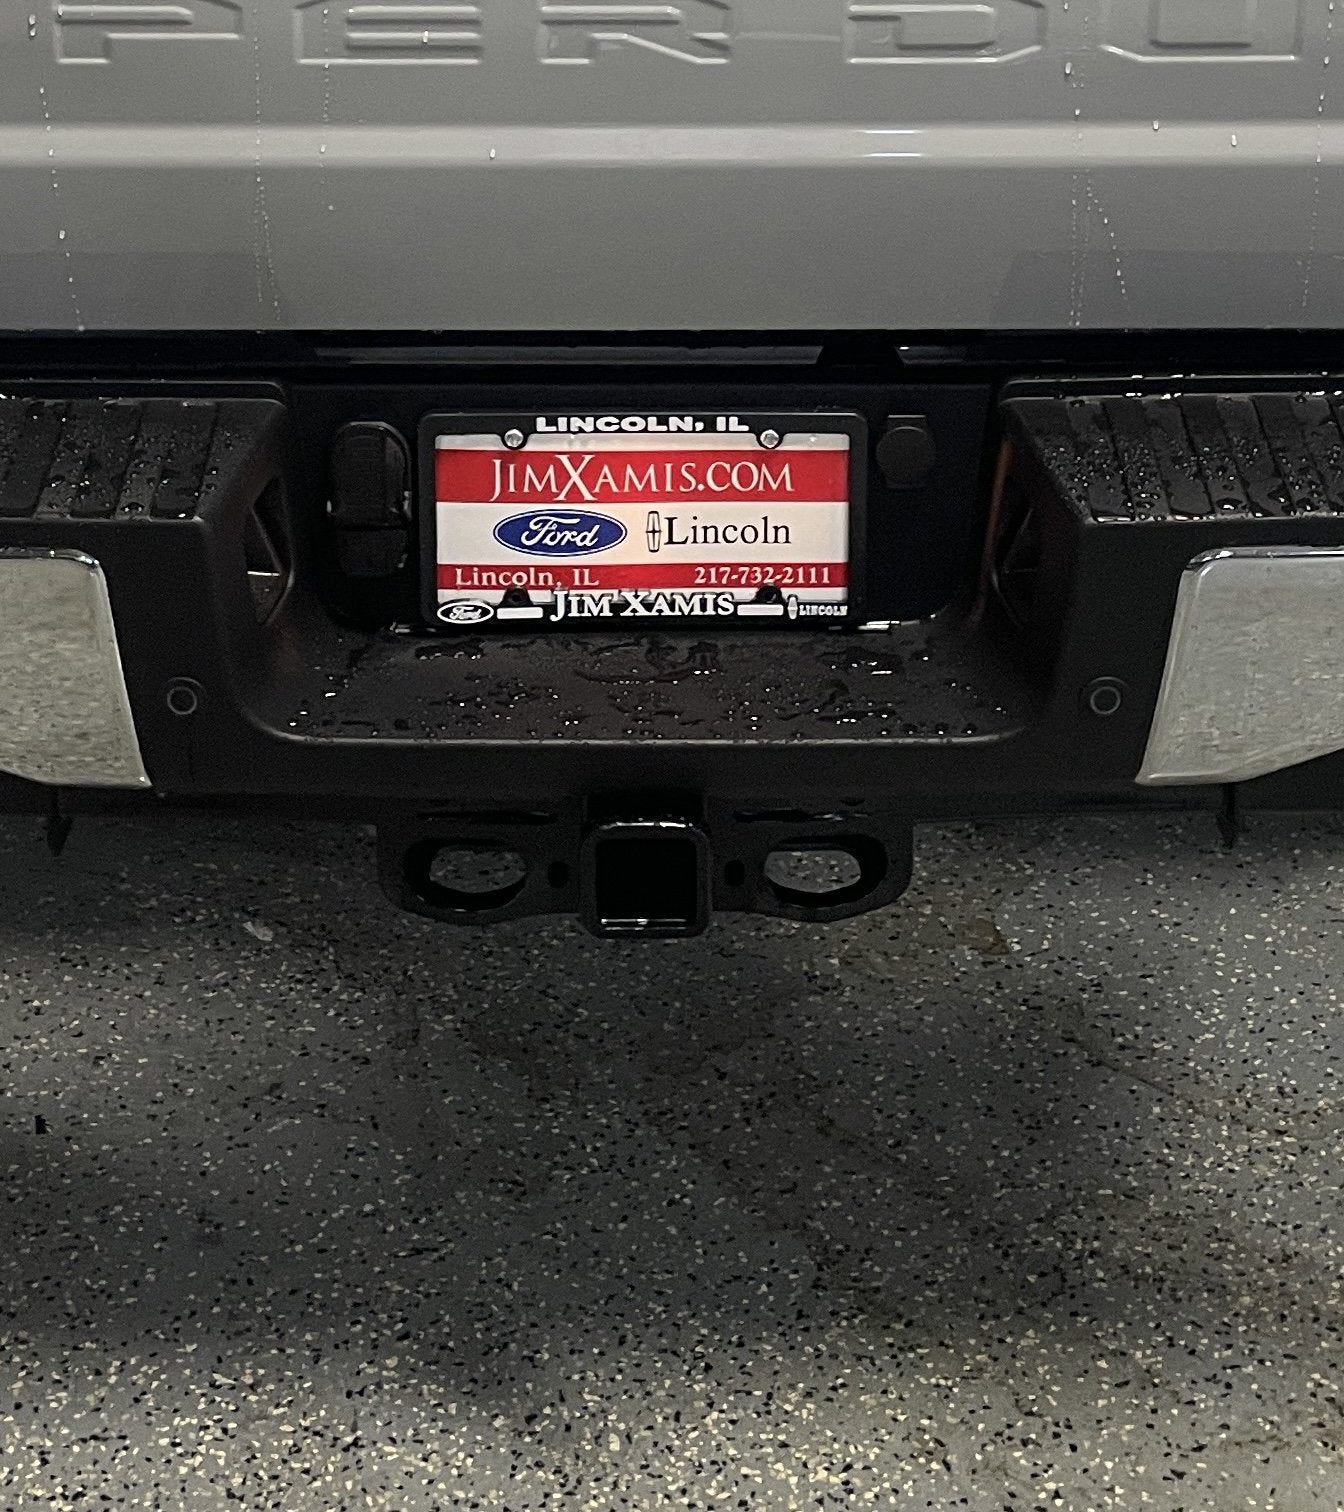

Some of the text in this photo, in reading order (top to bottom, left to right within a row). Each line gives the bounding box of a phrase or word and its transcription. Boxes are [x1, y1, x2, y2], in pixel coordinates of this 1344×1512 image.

[536, 416, 749, 433] LINCOLN, IL
[521, 515, 600, 548] Ford
[664, 516, 792, 545] Lincoln
[455, 568, 600, 589] Lincoln, IL
[694, 566, 831, 584] 217-732-2111
[799, 605, 848, 616] LINCOLN
